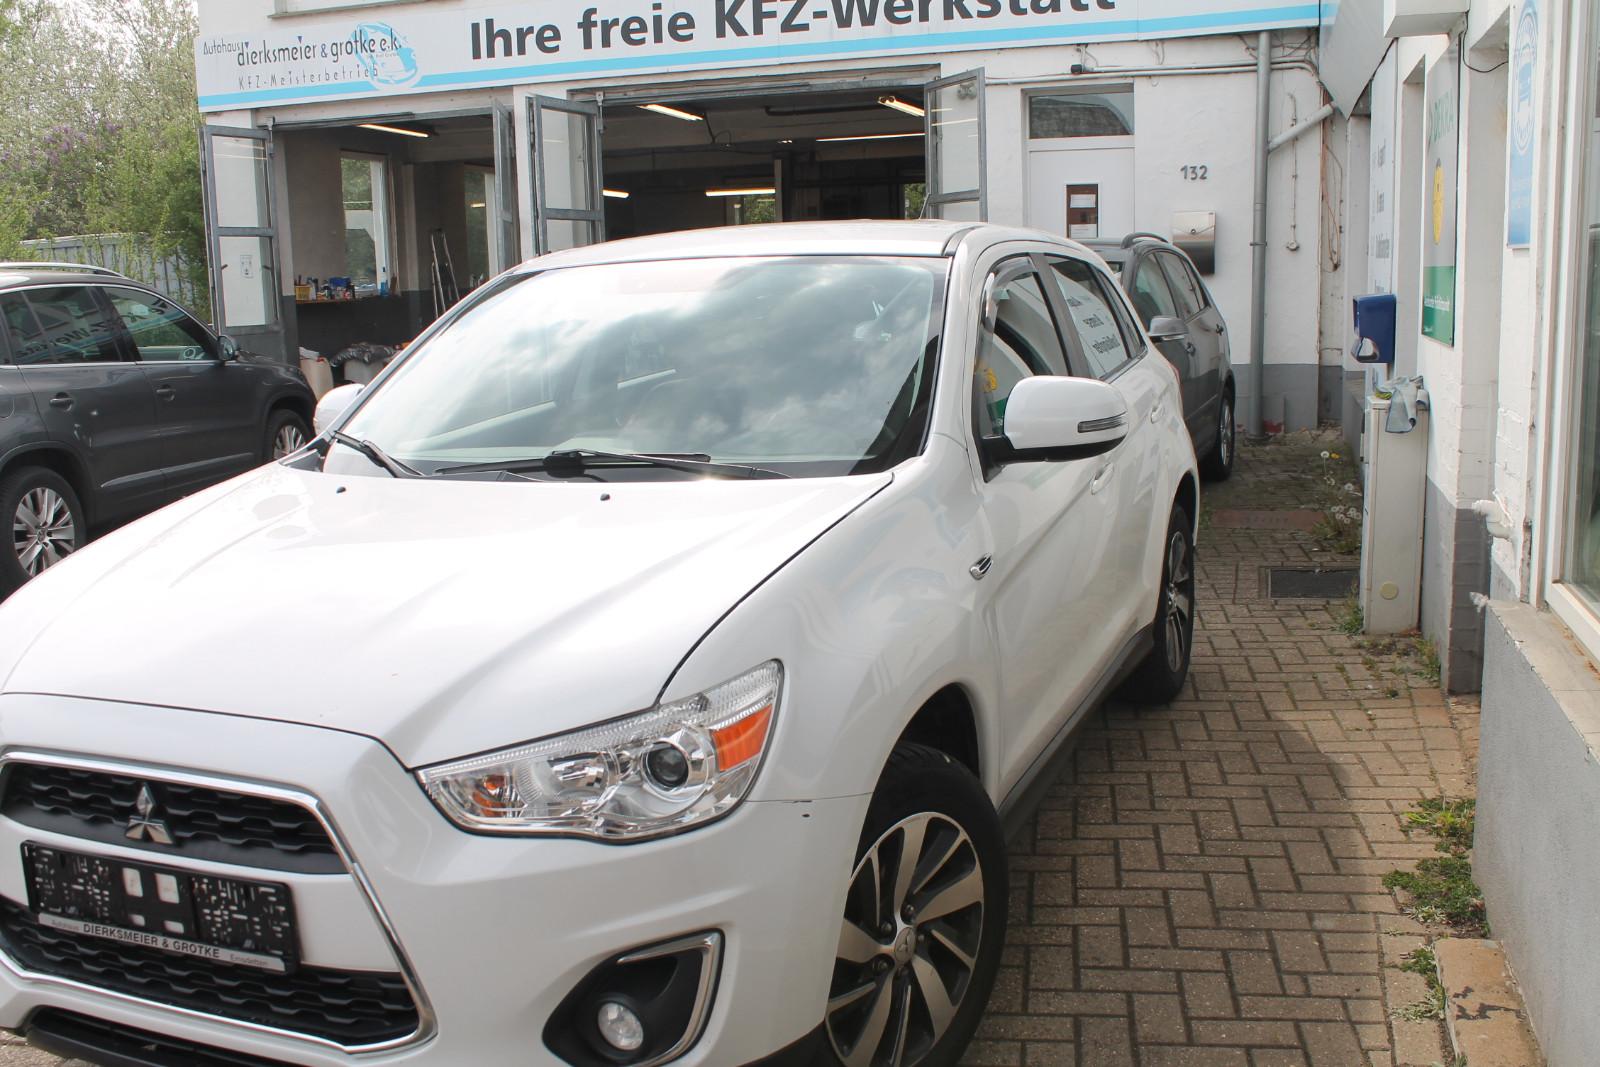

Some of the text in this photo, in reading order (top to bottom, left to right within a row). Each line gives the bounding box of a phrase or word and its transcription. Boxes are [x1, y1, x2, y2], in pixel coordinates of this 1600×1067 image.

[237, 36, 316, 66] dierksmeier
[320, 43, 328, 58] &
[330, 29, 376, 63] grotke
[471, 0, 1116, 60] Ihre freie KFZ-Werksa
[1180, 165, 1208, 180] 132
[83, 923, 159, 947] DIERKSMEIER
[162, 938, 169, 948] &
[173, 940, 220, 959] GROTKE
